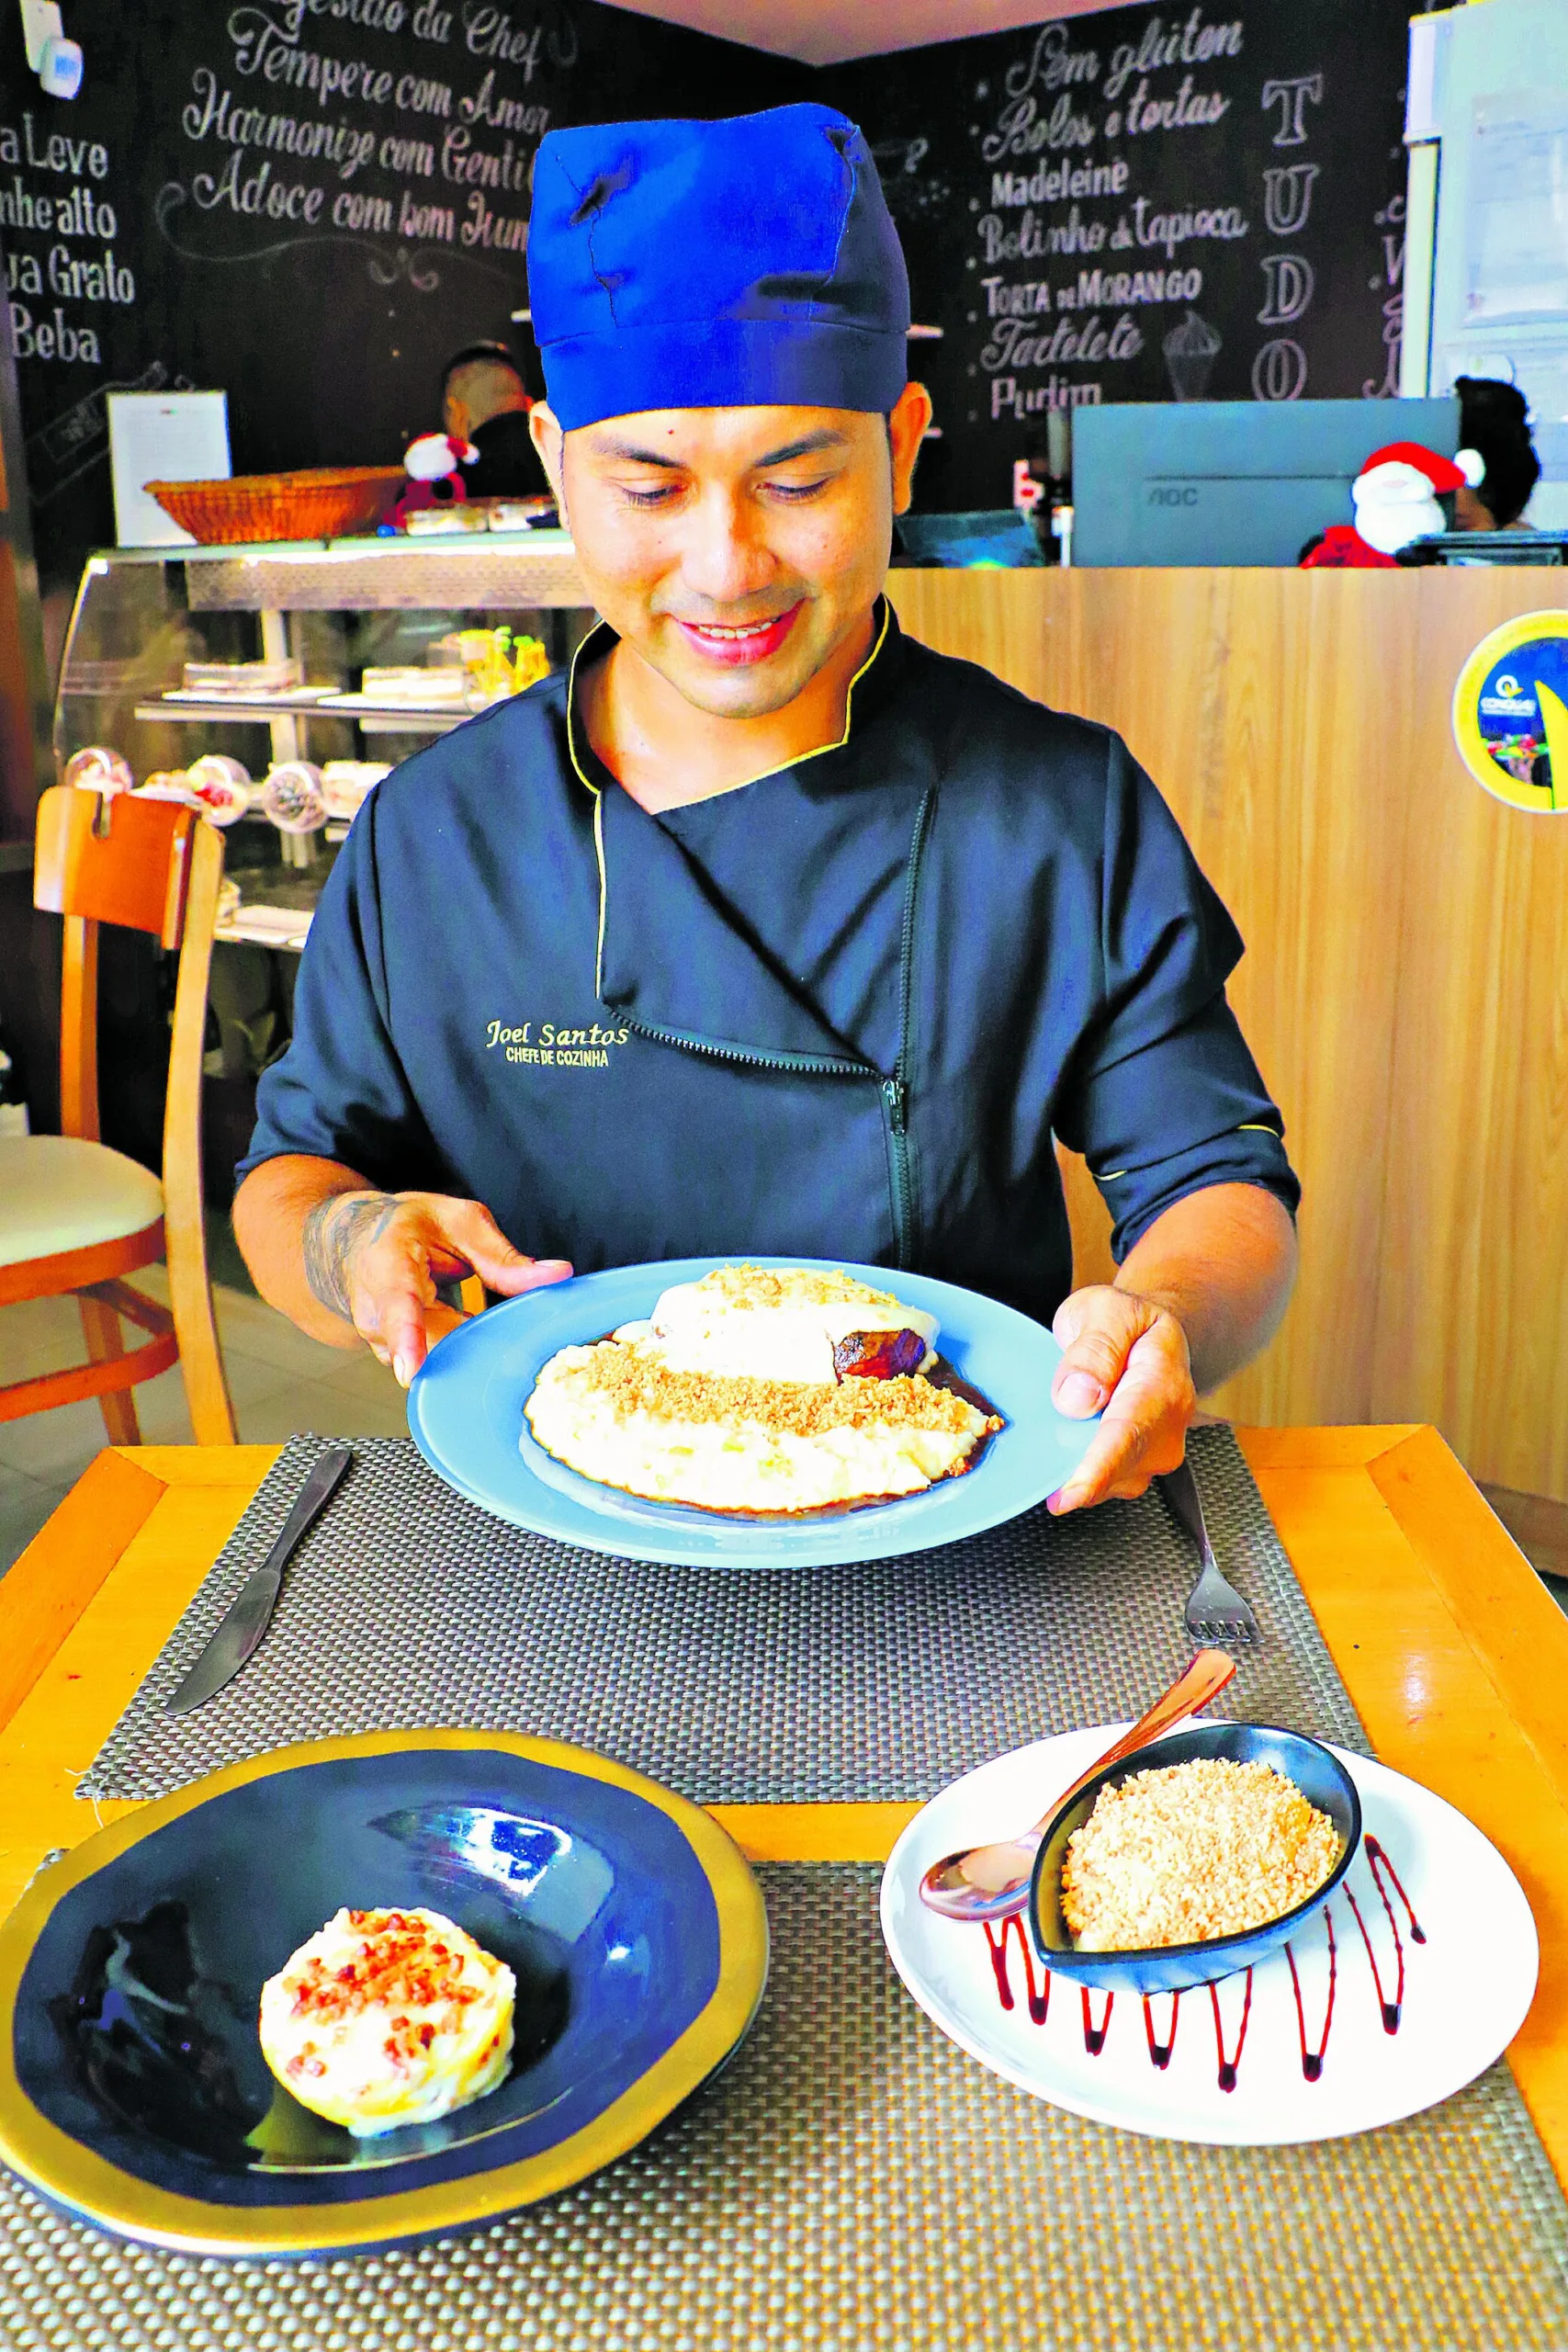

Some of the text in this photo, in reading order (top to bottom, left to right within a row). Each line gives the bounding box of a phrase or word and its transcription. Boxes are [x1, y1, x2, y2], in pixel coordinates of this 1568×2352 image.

[227, 6, 550, 136] Tempere com Amor
[465, 6, 542, 84] Chef
[1005, 21, 1100, 96] Sem
[183, 67, 535, 192] Harmonize com Genti
[1126, 74, 1232, 135] tortas
[22, 110, 108, 180] Leve
[55, 186, 117, 239] alto
[193, 148, 324, 225] Adoce
[333, 191, 393, 232] com
[397, 189, 456, 243] bom
[977, 204, 1106, 265] Bolinho
[1131, 195, 1250, 260] tapioca
[49, 243, 135, 304] Grato
[9, 300, 100, 365] Beba
[991, 373, 1101, 421] Pudim
[1146, 487, 1199, 507] AOC
[486, 1020, 630, 1048] Joel Santos
[506, 1046, 609, 1068] CHEFE DE COZINHA
